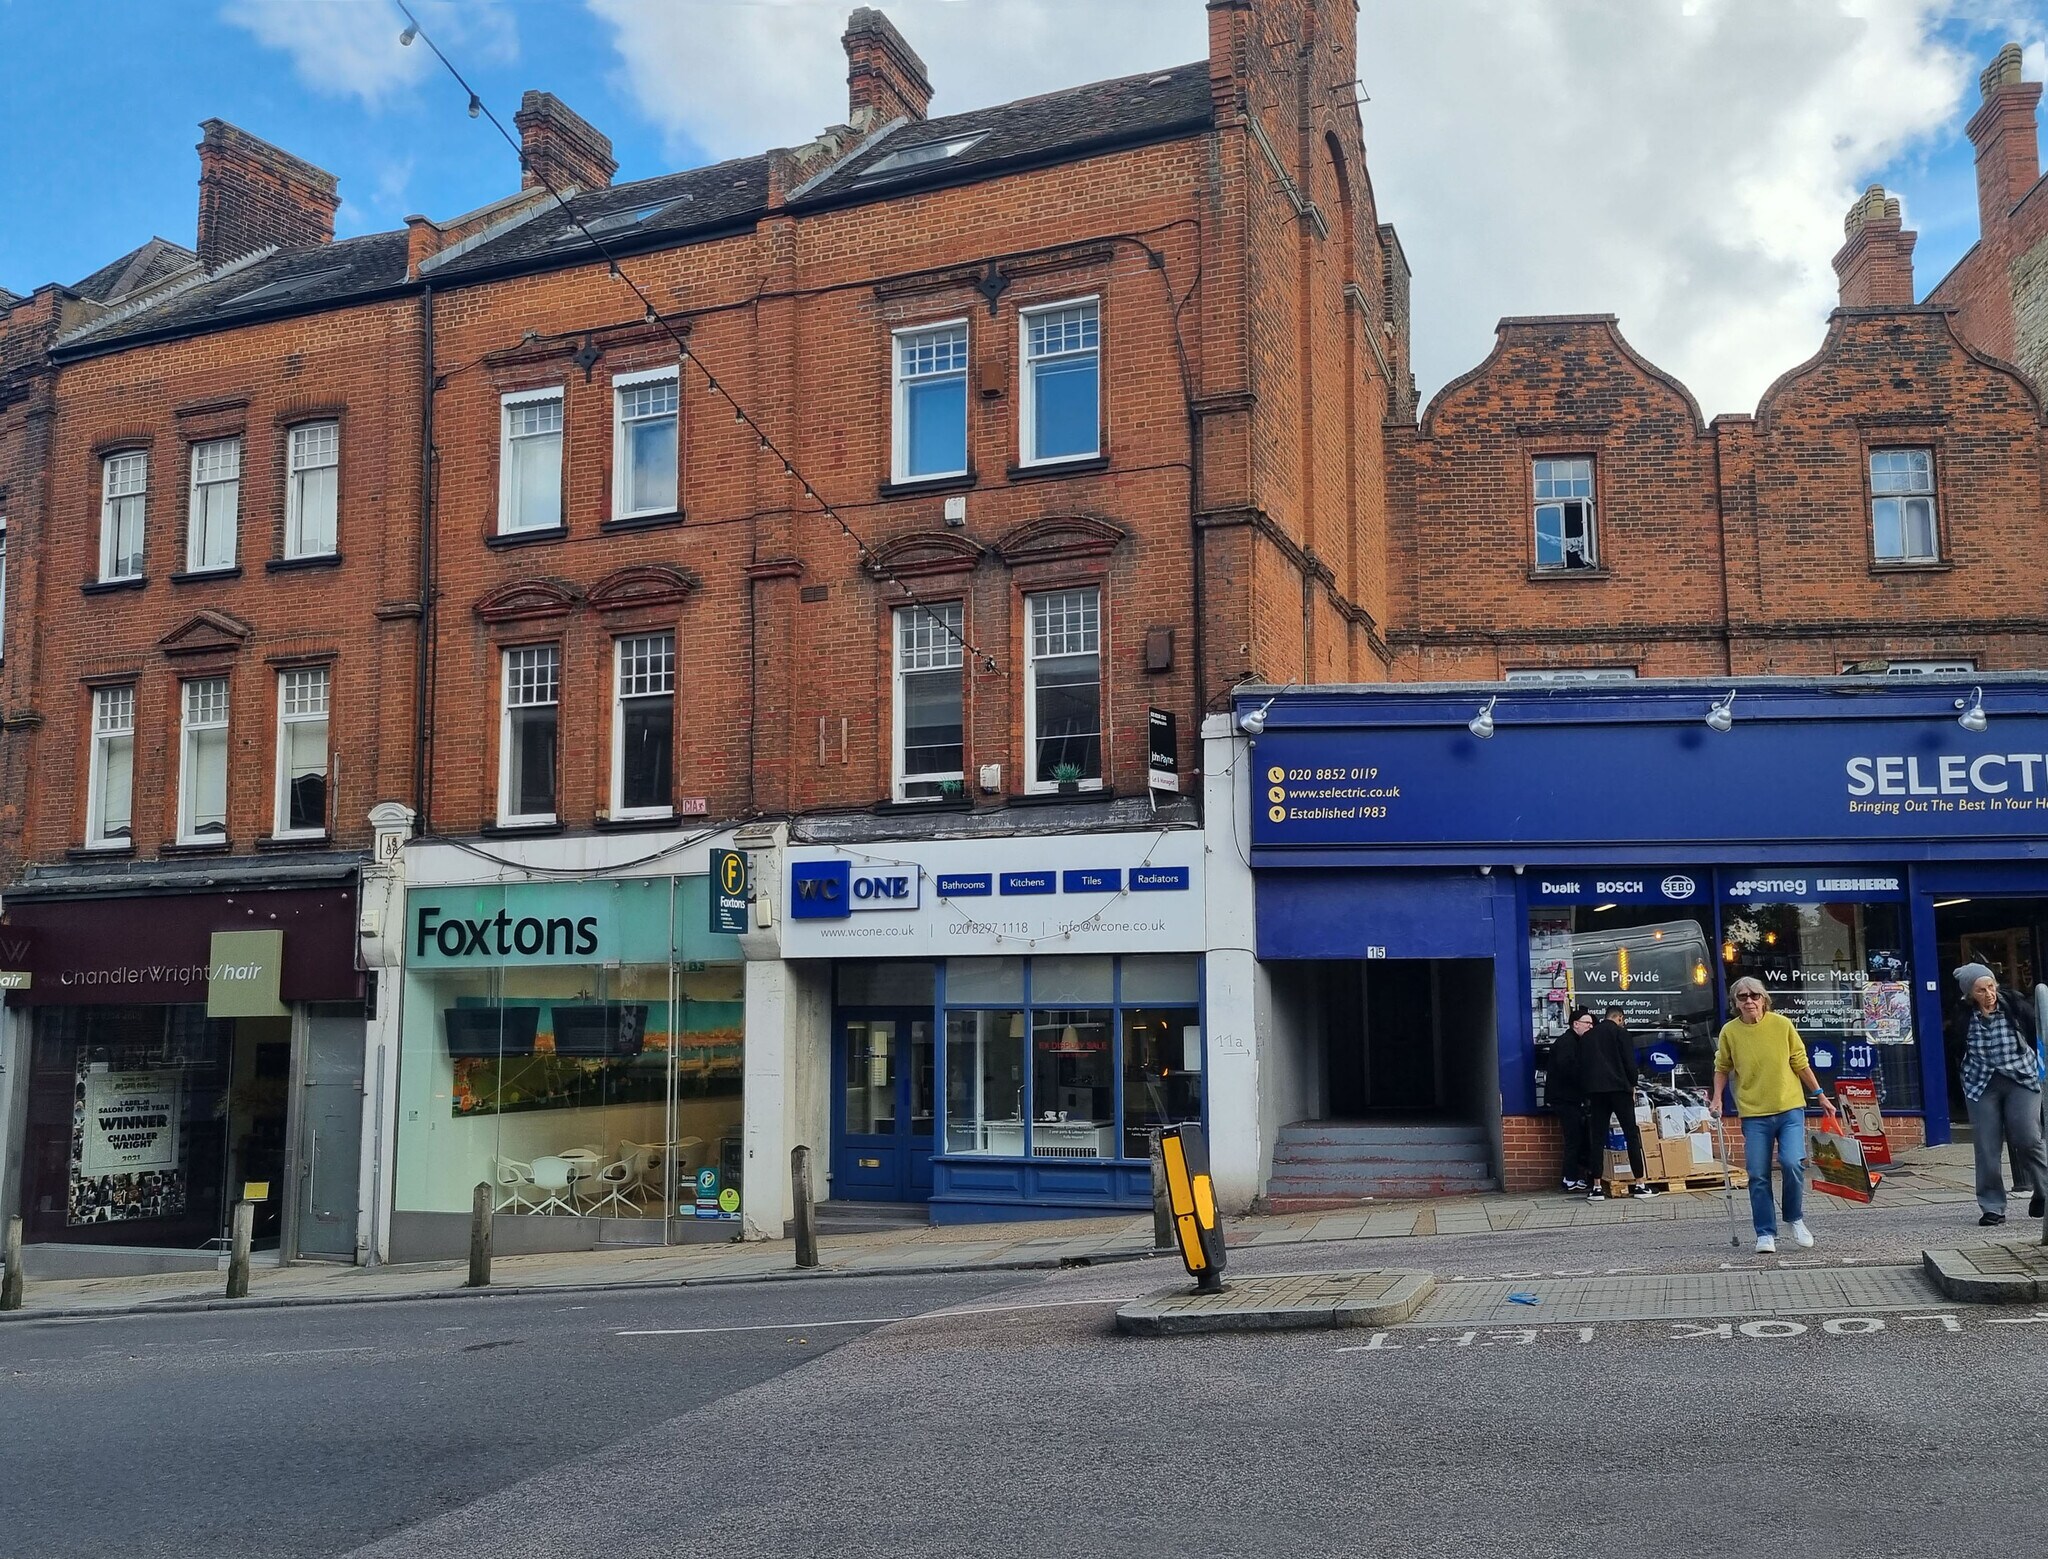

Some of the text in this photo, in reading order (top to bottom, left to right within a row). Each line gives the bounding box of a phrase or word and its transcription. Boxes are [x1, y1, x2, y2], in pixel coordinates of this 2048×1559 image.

[1289, 768, 1378, 780] 020 8852 0119
[1846, 753, 2048, 796] SELECT
[1289, 786, 1400, 799] www.selectric.co.uk
[1849, 797, 2048, 815] Bringing Out The Best In Your H
[1290, 806, 1387, 819] Established 1983
[727, 859, 737, 888] F
[1138, 874, 1179, 883] Radiators
[942, 881, 985, 890] Bathrooms
[1010, 878, 1045, 887] Kitchens
[1082, 876, 1102, 885] Tiles
[1816, 878, 1900, 892] LIEBHERR
[797, 877, 910, 900] WC ONE
[1542, 882, 1580, 894] Dualit
[1597, 882, 1643, 893] BOSCH
[1664, 882, 1693, 892] SEBO
[1756, 879, 1807, 895] smeg
[720, 895, 746, 909] Foxtons
[417, 907, 599, 957] Foxtons
[820, 919, 1166, 937] www.wcone.co.uk 020 8297 1118 info@wcone.co.uk
[1370, 947, 1384, 957] 15
[0, 974, 22, 986] air
[1584, 970, 1607, 982] We
[1765, 969, 1869, 982] We Price Match
[1625, 999, 1652, 1007] delivery,
[1806, 999, 1825, 1007] price
[1826, 998, 1845, 1006] match
[1807, 1008, 1830, 1016] against
[1830, 1007, 1845, 1015] High
[1824, 1016, 1853, 1024] suppliers
[1215, 1034, 1243, 1048] 11a
[98, 1114, 168, 1131] WINNER
[107, 1132, 158, 1143] CHANDLER
[113, 1140, 152, 1150] WRIGHT
[122, 1154, 141, 1162] 2021
[1669, 1315, 1963, 1339] LOOK
